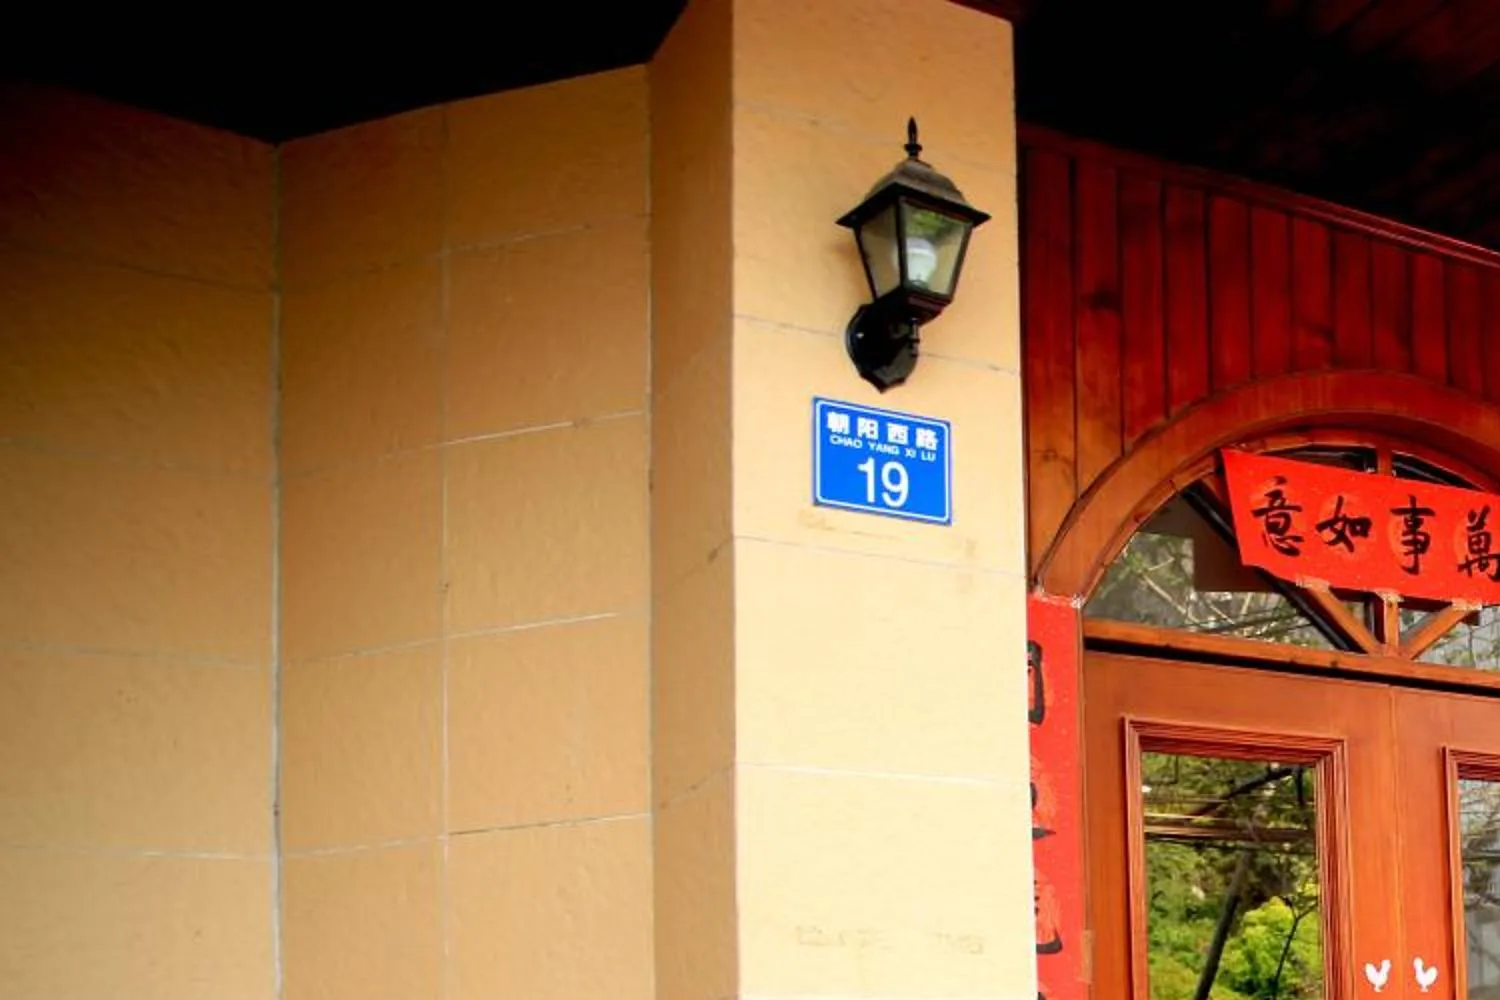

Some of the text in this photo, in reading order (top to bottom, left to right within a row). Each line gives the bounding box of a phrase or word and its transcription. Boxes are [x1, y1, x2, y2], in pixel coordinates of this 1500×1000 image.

[827, 412, 937, 449] 朝阳西路
[830, 434, 936, 462] CHAO YANG XI LU
[857, 457, 909, 507] 19
